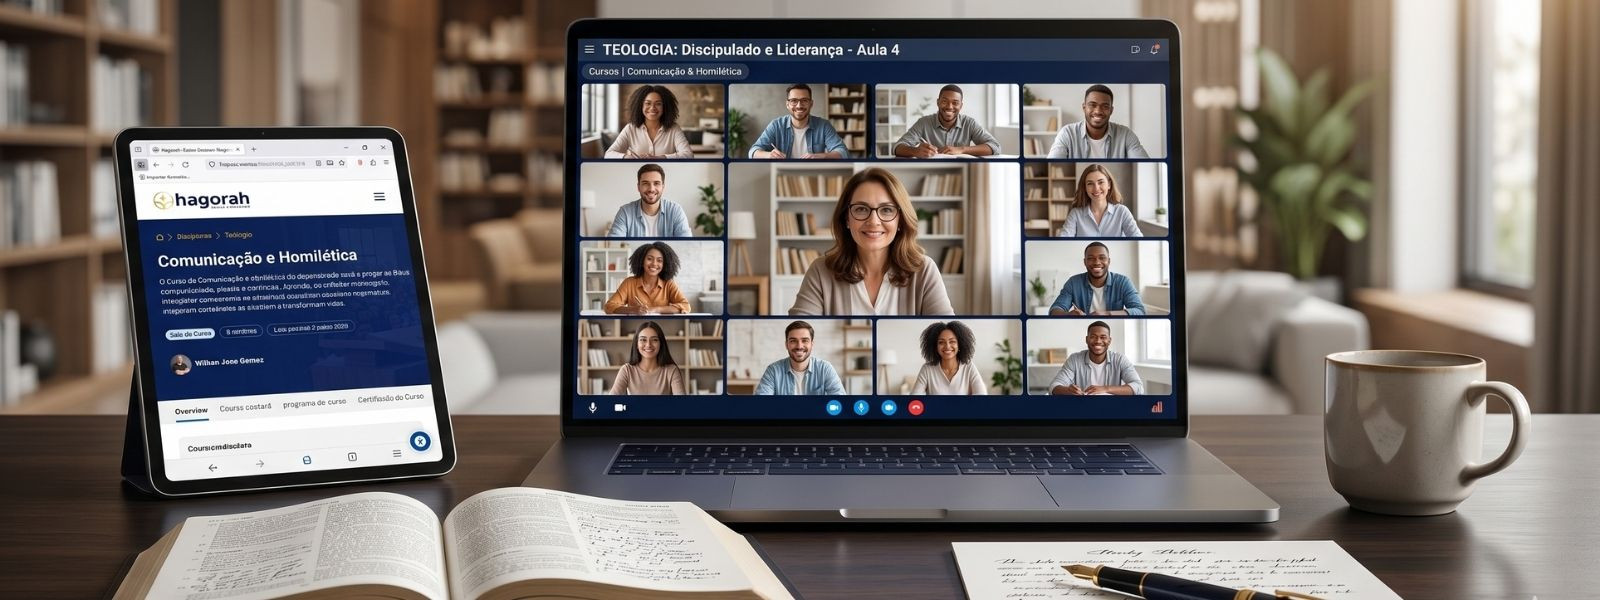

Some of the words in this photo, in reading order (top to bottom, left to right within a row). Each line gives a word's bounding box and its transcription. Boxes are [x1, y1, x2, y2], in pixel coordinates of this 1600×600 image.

[603, 44, 678, 56] TEOLOGIA:
[682, 44, 761, 58] Discipulado
[765, 46, 774, 56] e
[777, 44, 844, 59] Liderança
[857, 44, 888, 56] Aula
[891, 44, 900, 56] 4
[589, 68, 619, 76] Cursos
[628, 67, 686, 78] Comunicação
[688, 68, 694, 76] &
[696, 67, 742, 76] Homilética
[175, 192, 250, 209] hagorah
[158, 252, 262, 268] Comunicação
[266, 254, 275, 264] e
[279, 249, 358, 264] Homilética
[198, 275, 244, 284] Comunicação
[283, 401, 316, 410] programa
